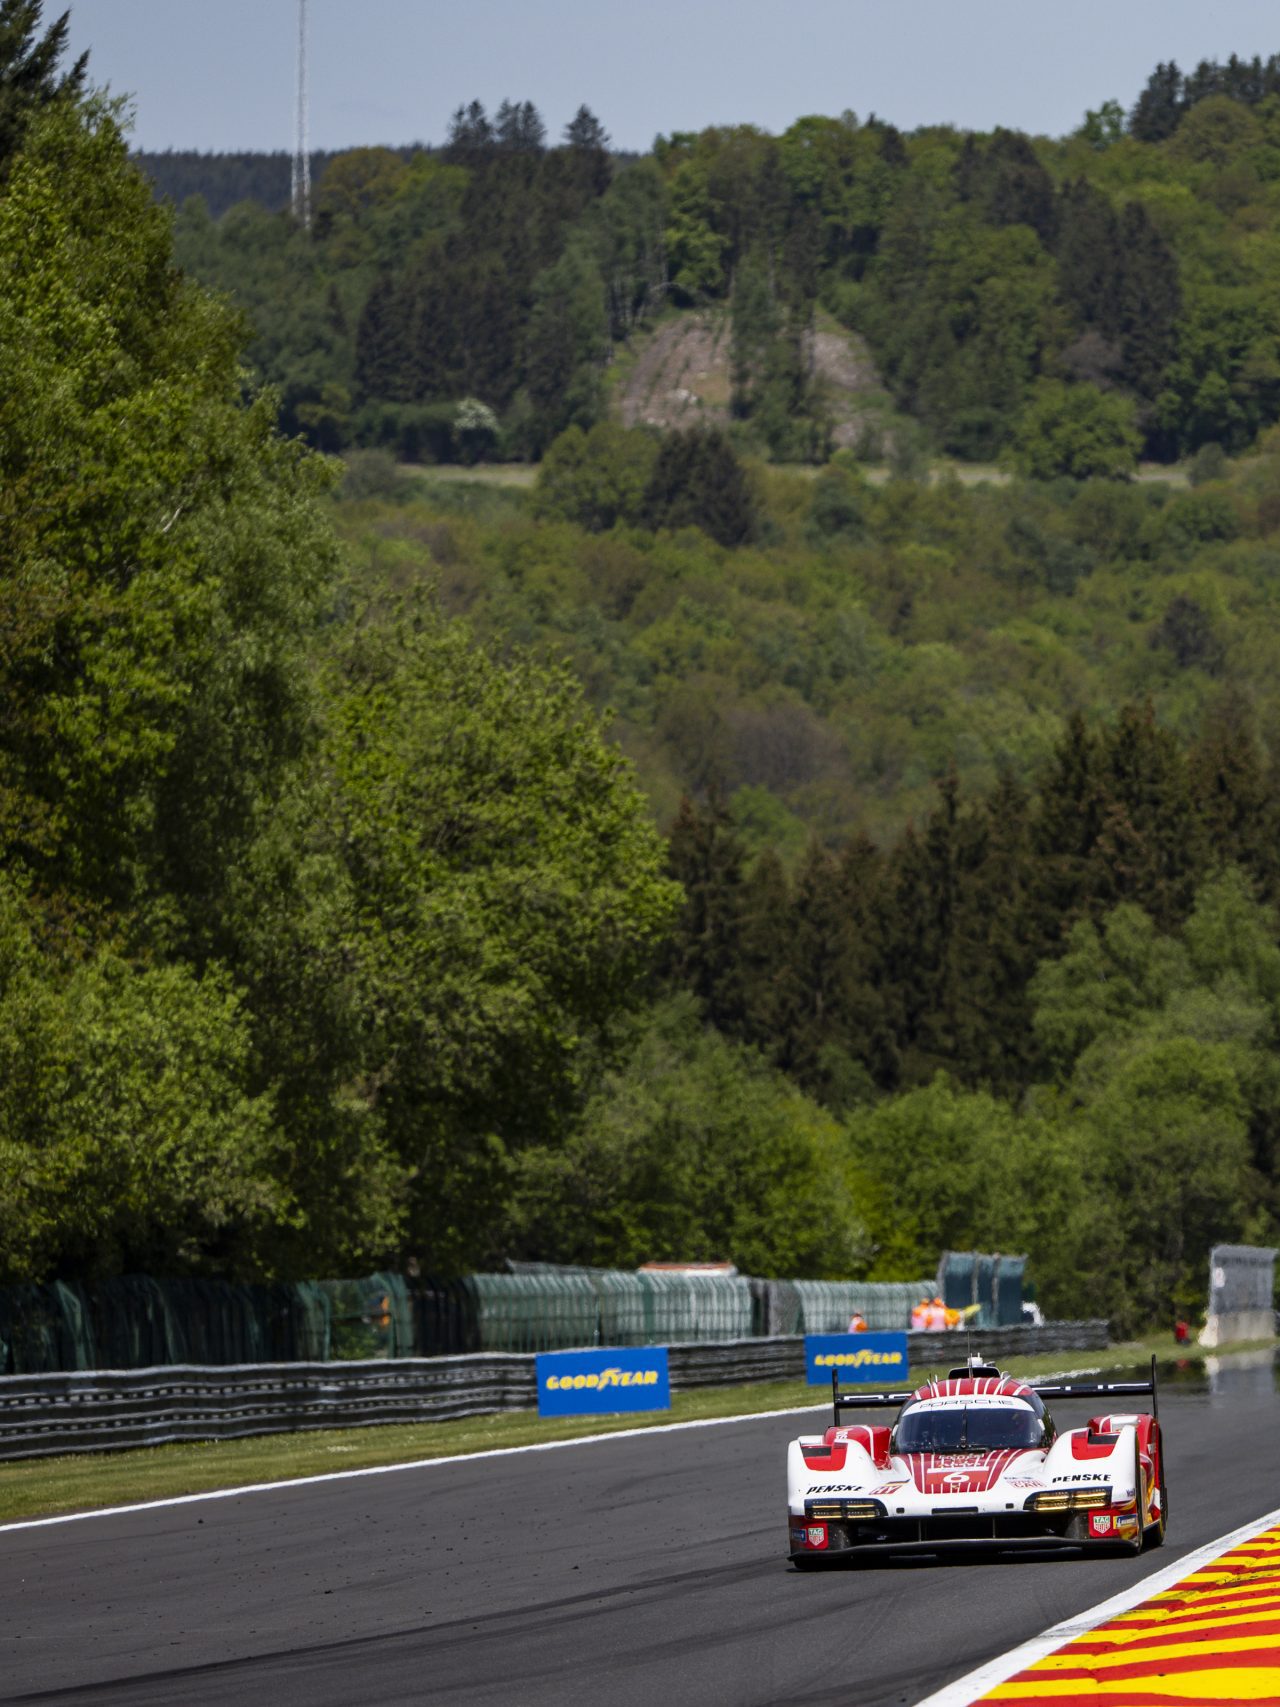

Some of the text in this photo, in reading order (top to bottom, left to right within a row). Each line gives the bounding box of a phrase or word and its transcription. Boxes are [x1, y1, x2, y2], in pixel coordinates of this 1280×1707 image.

[814, 1349, 903, 1368] GOODYEAR
[545, 1367, 659, 1391] GOODYEAR
[919, 1399, 1014, 1409] PORSCHE
[943, 1471, 971, 1483] 6
[1052, 1473, 1112, 1484] PENSKE
